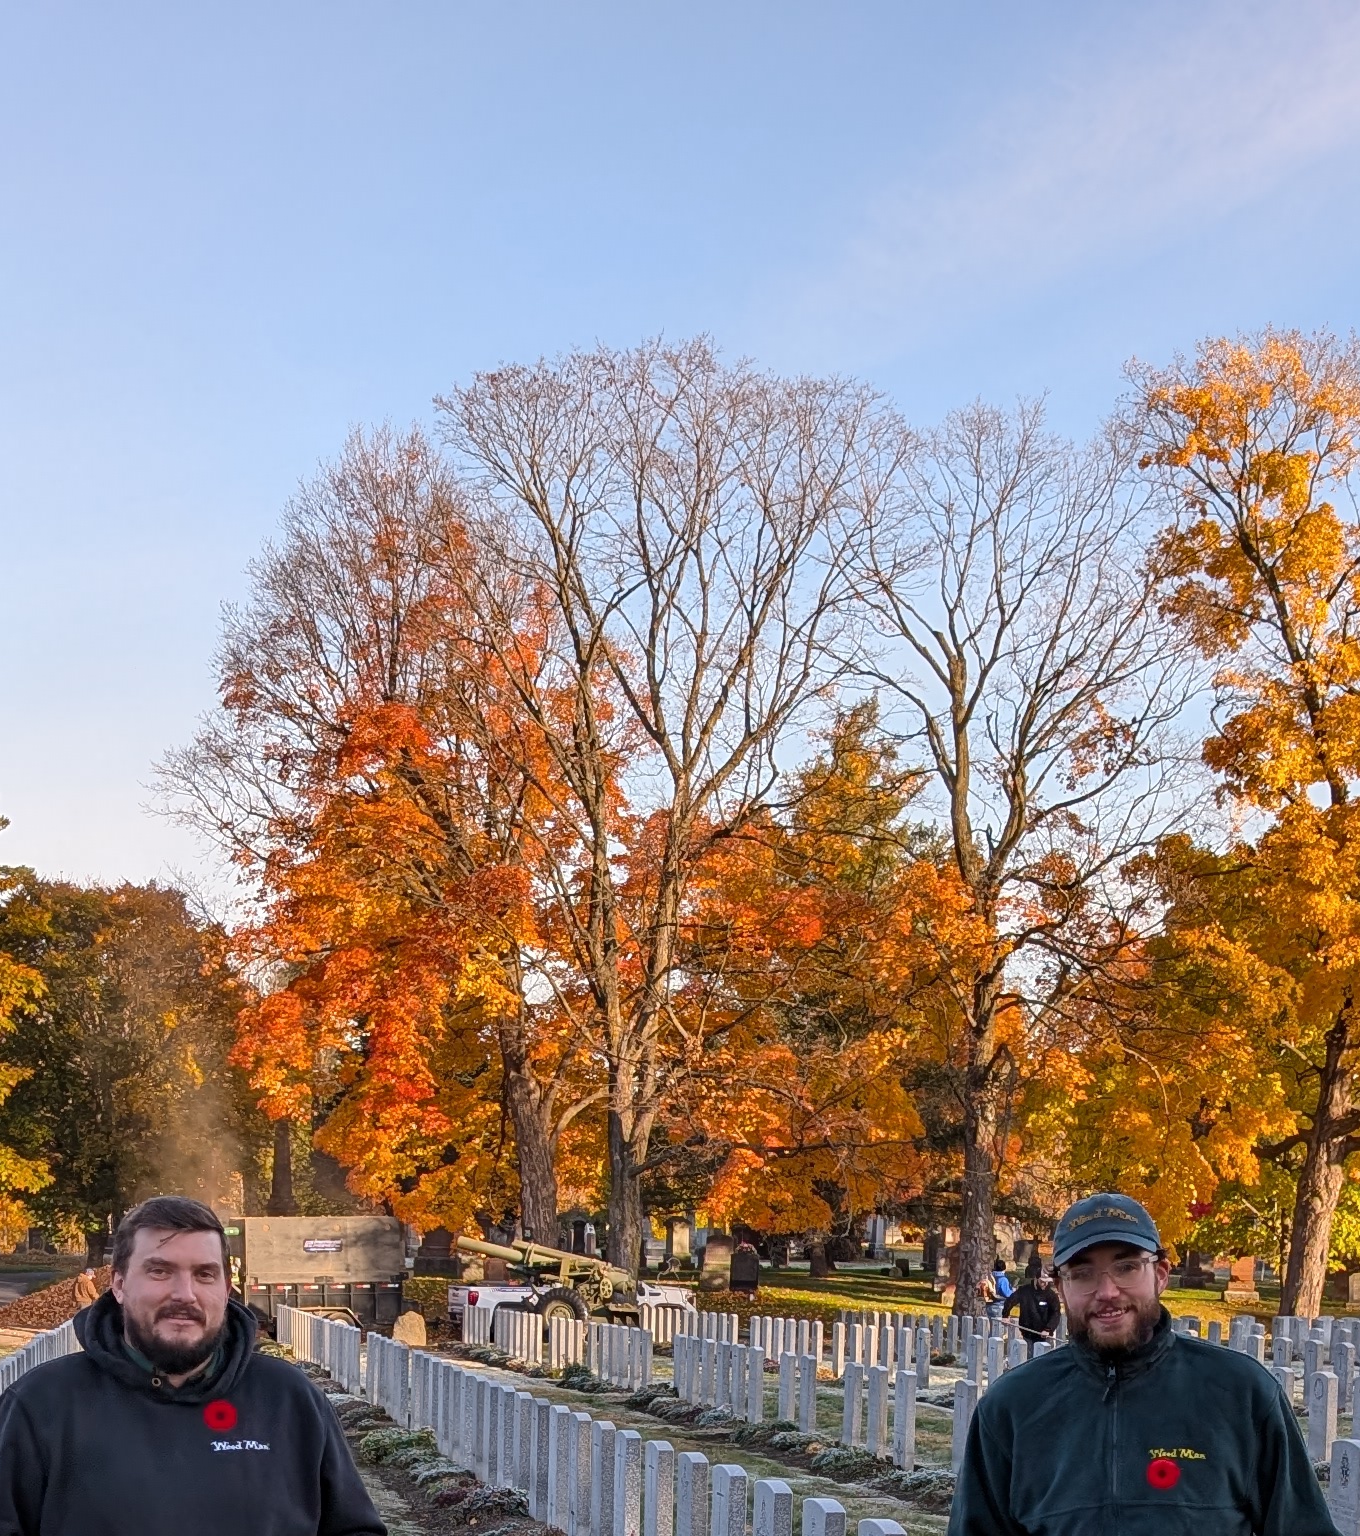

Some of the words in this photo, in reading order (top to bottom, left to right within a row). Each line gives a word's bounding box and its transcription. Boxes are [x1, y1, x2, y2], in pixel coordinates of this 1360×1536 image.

[211, 1440, 243, 1452] Weed
[243, 1439, 270, 1451] Man
[1148, 1448, 1177, 1460] Weed
[1178, 1448, 1207, 1460] Man
